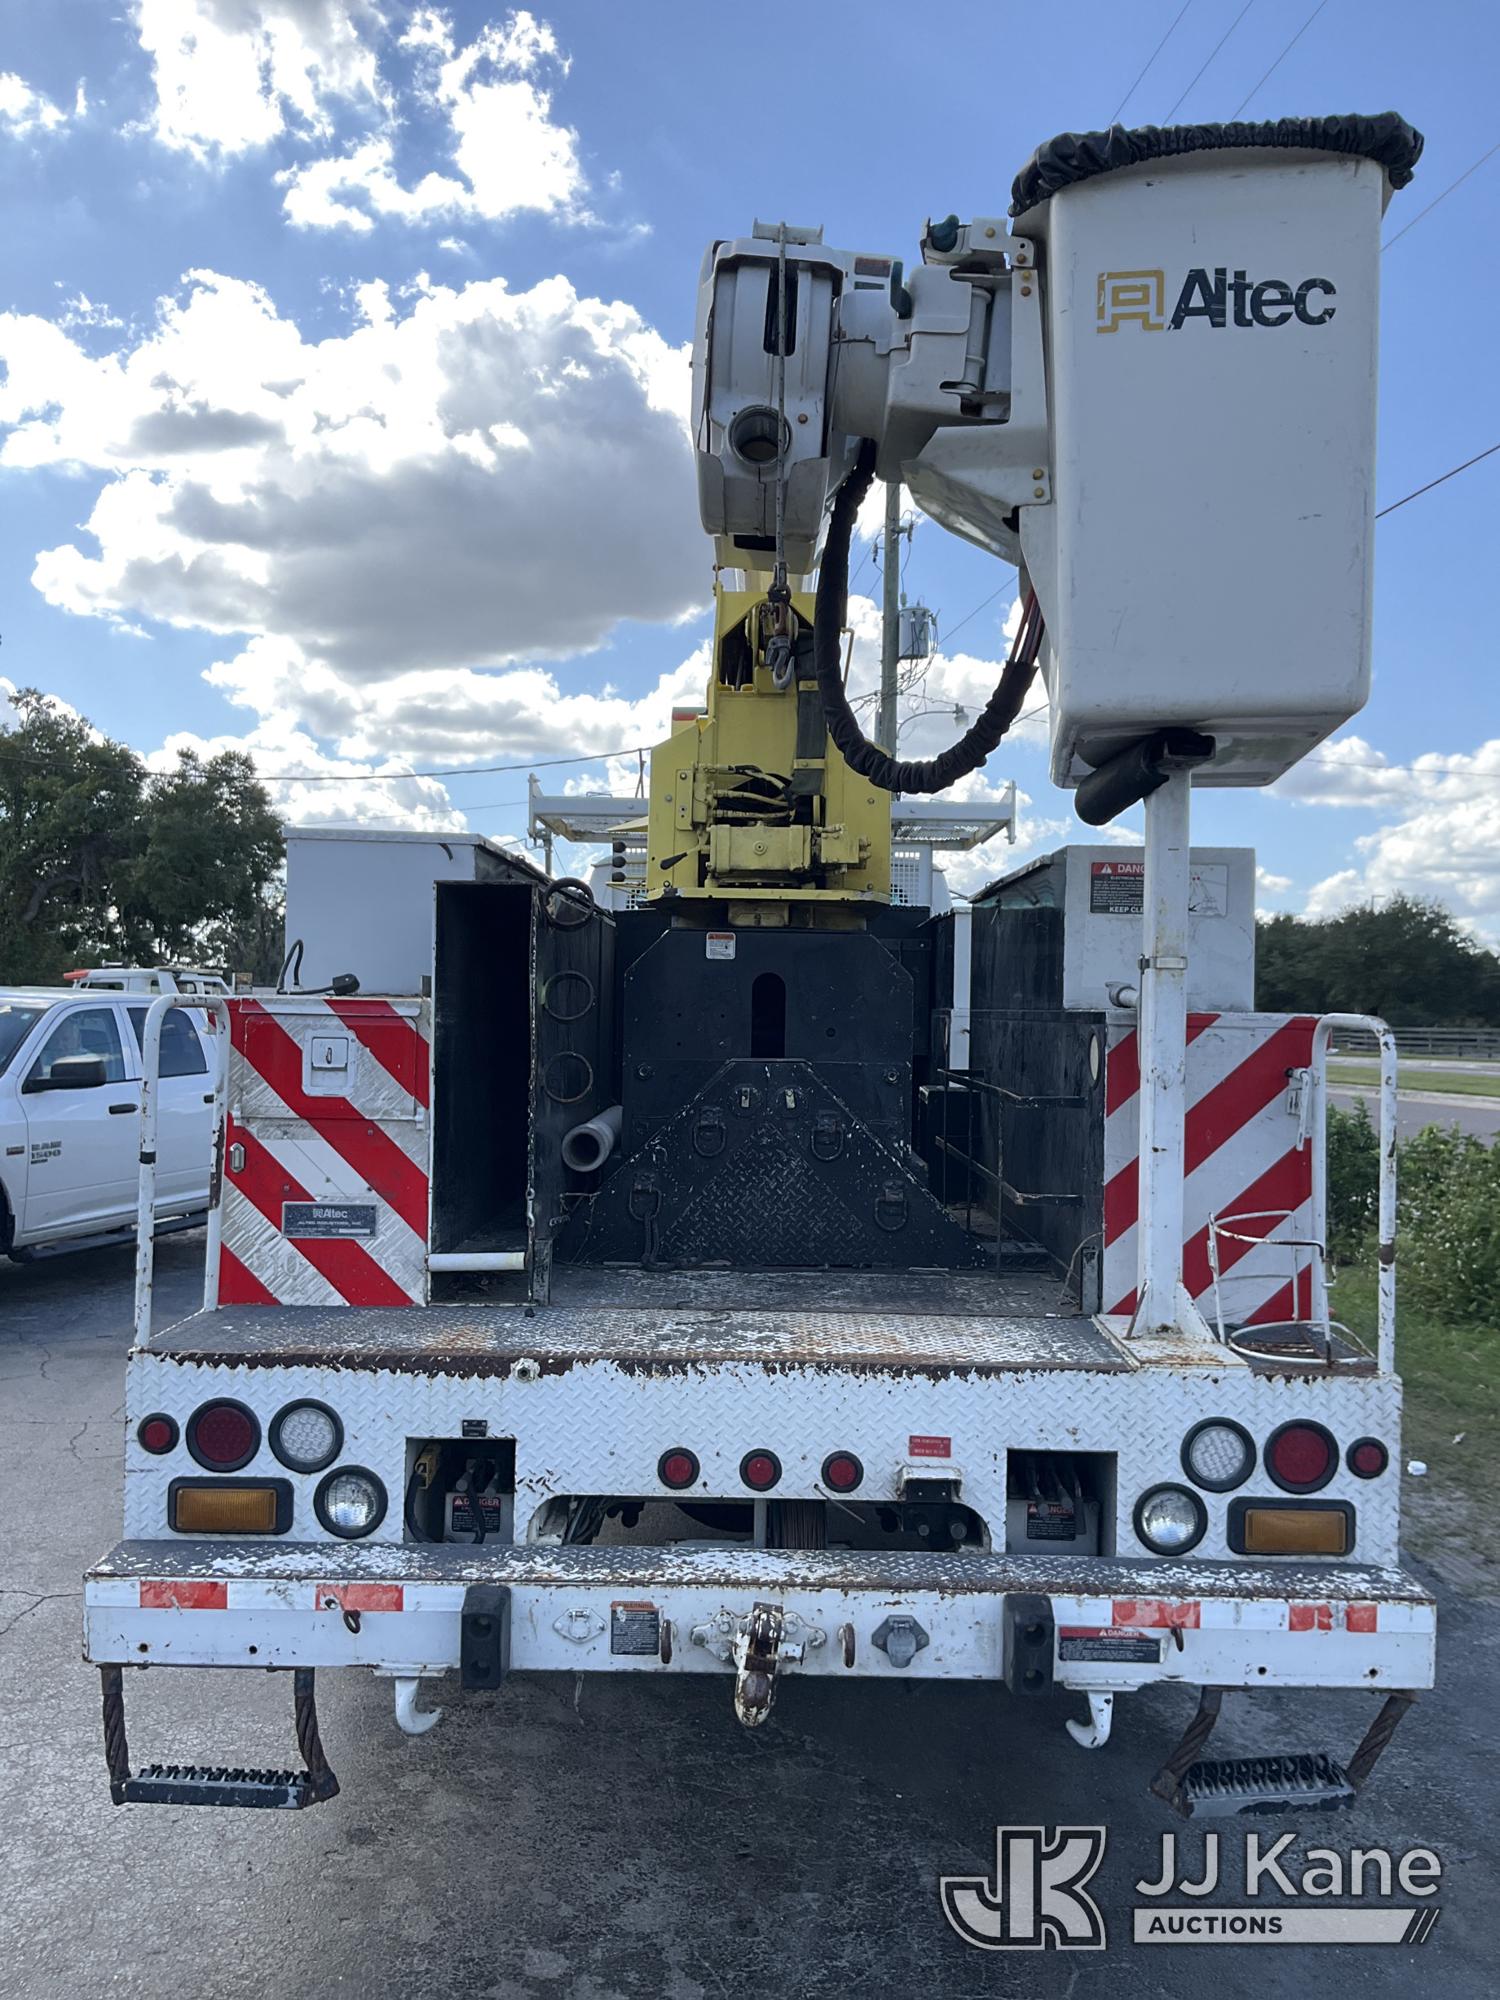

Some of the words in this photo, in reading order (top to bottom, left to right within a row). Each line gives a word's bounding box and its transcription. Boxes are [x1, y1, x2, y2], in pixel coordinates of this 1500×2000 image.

[1167, 267, 1337, 331] Altec
[31, 1149, 62, 1160] 1500
[325, 1207, 348, 1219] Altec
